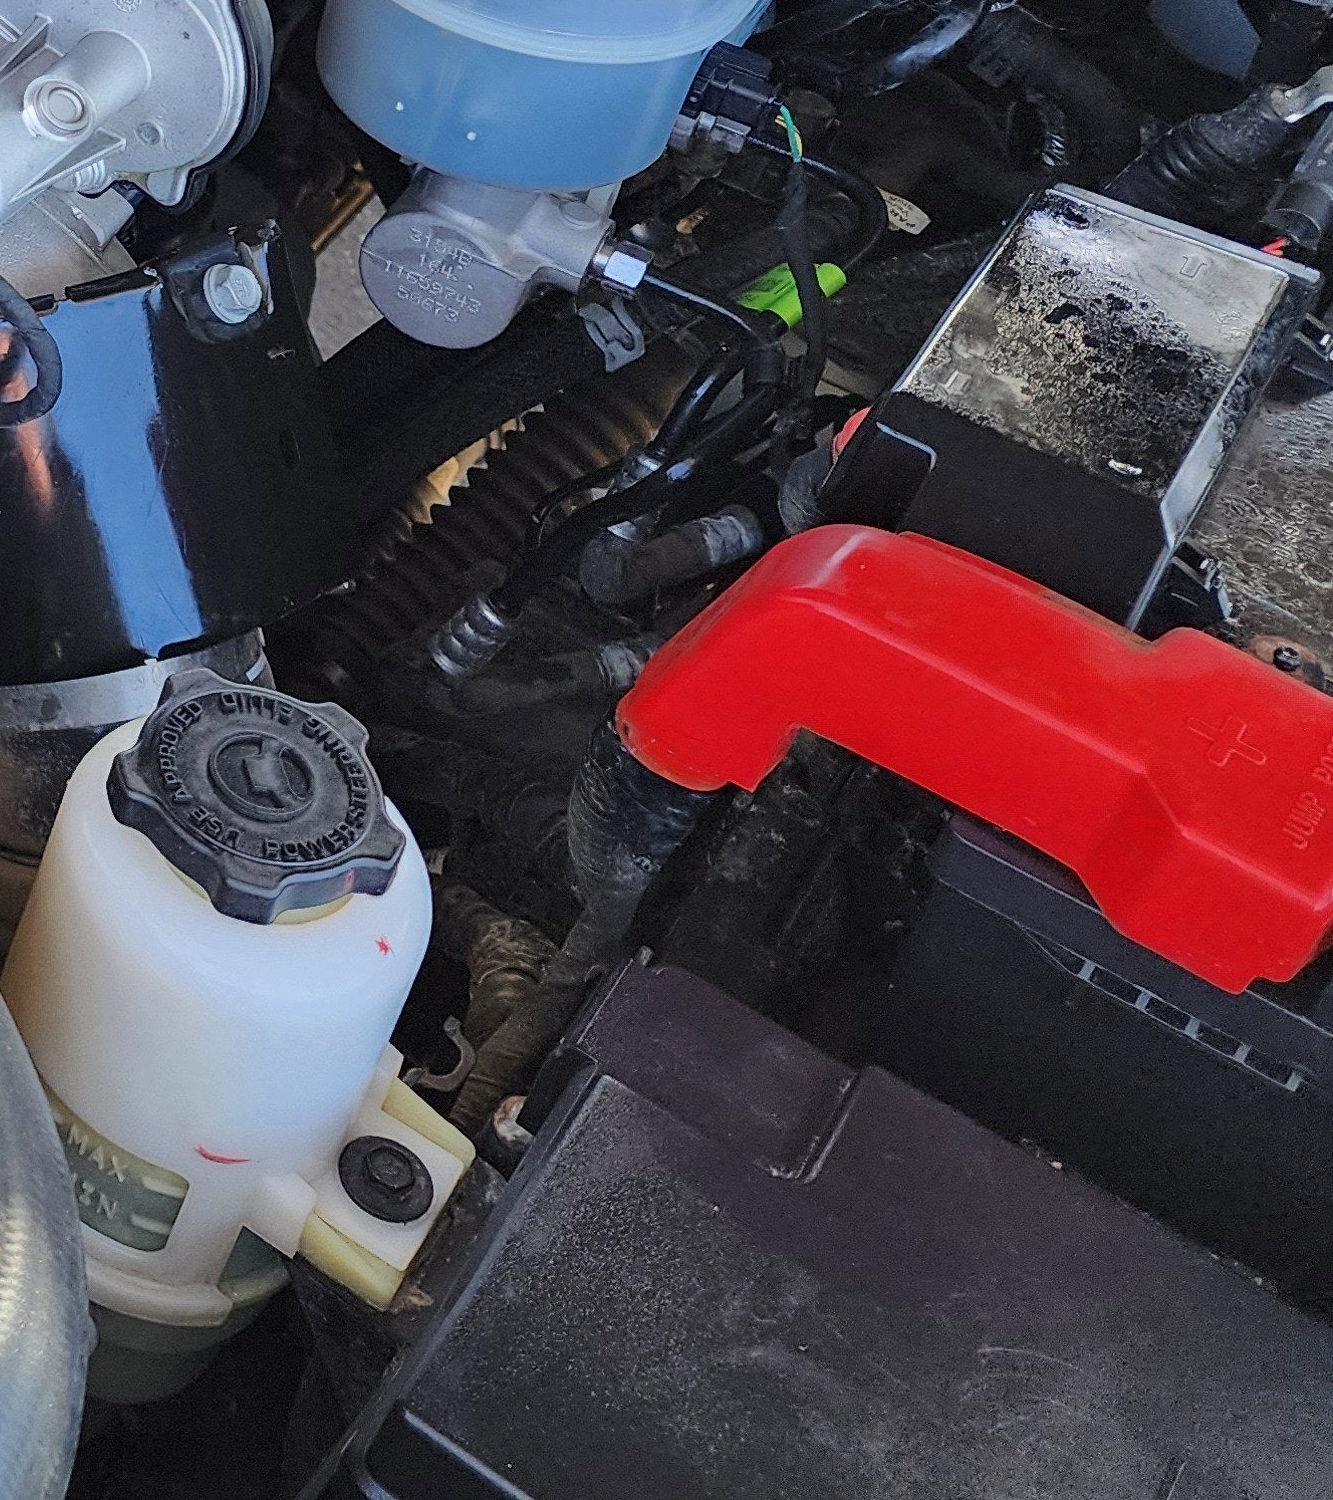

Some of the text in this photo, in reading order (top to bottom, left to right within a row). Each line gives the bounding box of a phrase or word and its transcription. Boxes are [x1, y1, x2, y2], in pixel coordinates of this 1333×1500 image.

[158, 700, 243, 849] USE APPROVED
[1282, 791, 1325, 850] JUMP
[66, 1122, 129, 1184] MAX
[70, 1172, 120, 1220] IN
